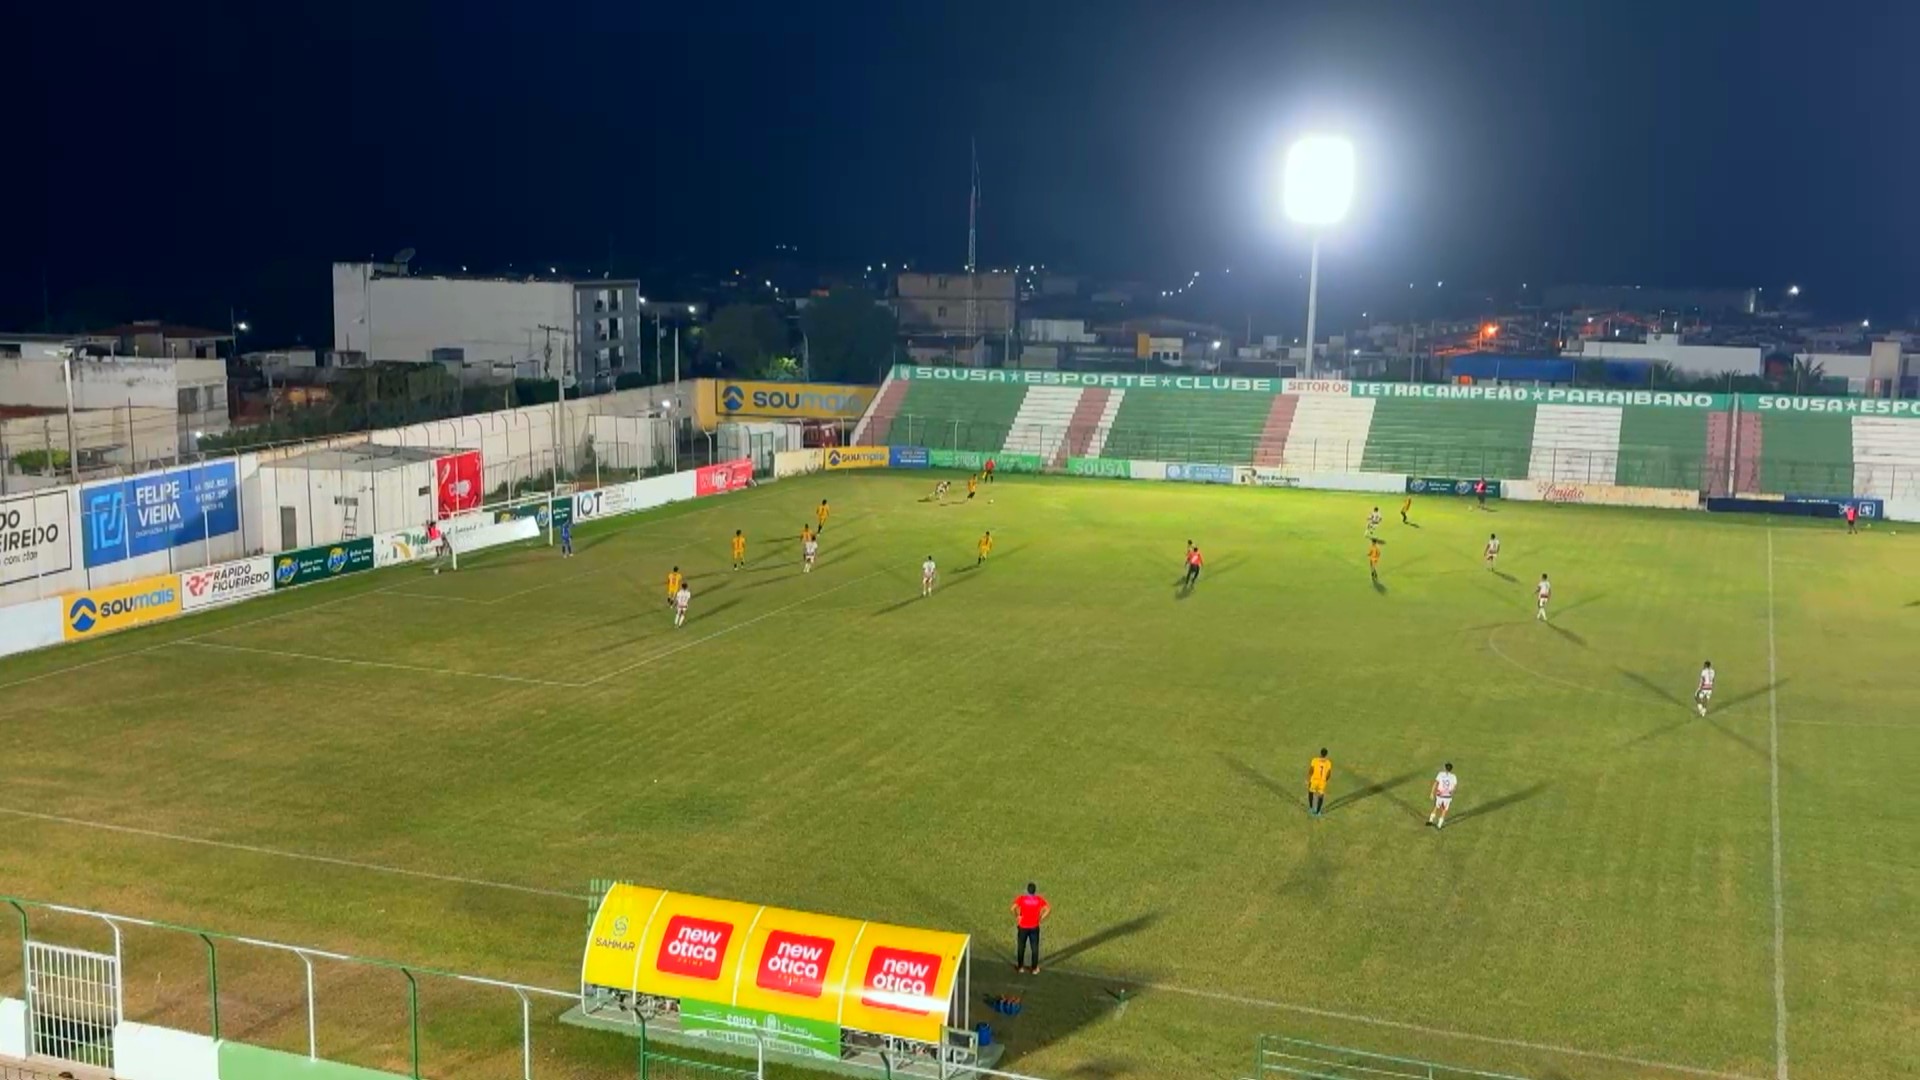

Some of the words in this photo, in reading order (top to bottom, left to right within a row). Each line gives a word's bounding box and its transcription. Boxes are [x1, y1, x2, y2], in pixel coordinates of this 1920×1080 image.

[915, 367, 1005, 383] SOUSA
[1024, 371, 1157, 387] ESPORTE
[1176, 376, 1271, 392] CLUBE
[1288, 380, 1330, 393] SETOR
[1333, 381, 1349, 393] 06
[1547, 388, 1713, 407] PARAIBANO
[1758, 396, 1843, 412] SOUSA
[1074, 461, 1125, 477] SOUSA
[135, 480, 180, 507] FELIPE
[211, 571, 270, 593] FIGUEIREDO
[678, 926, 722, 946] new
[777, 941, 823, 961] new
[883, 957, 930, 978] new
